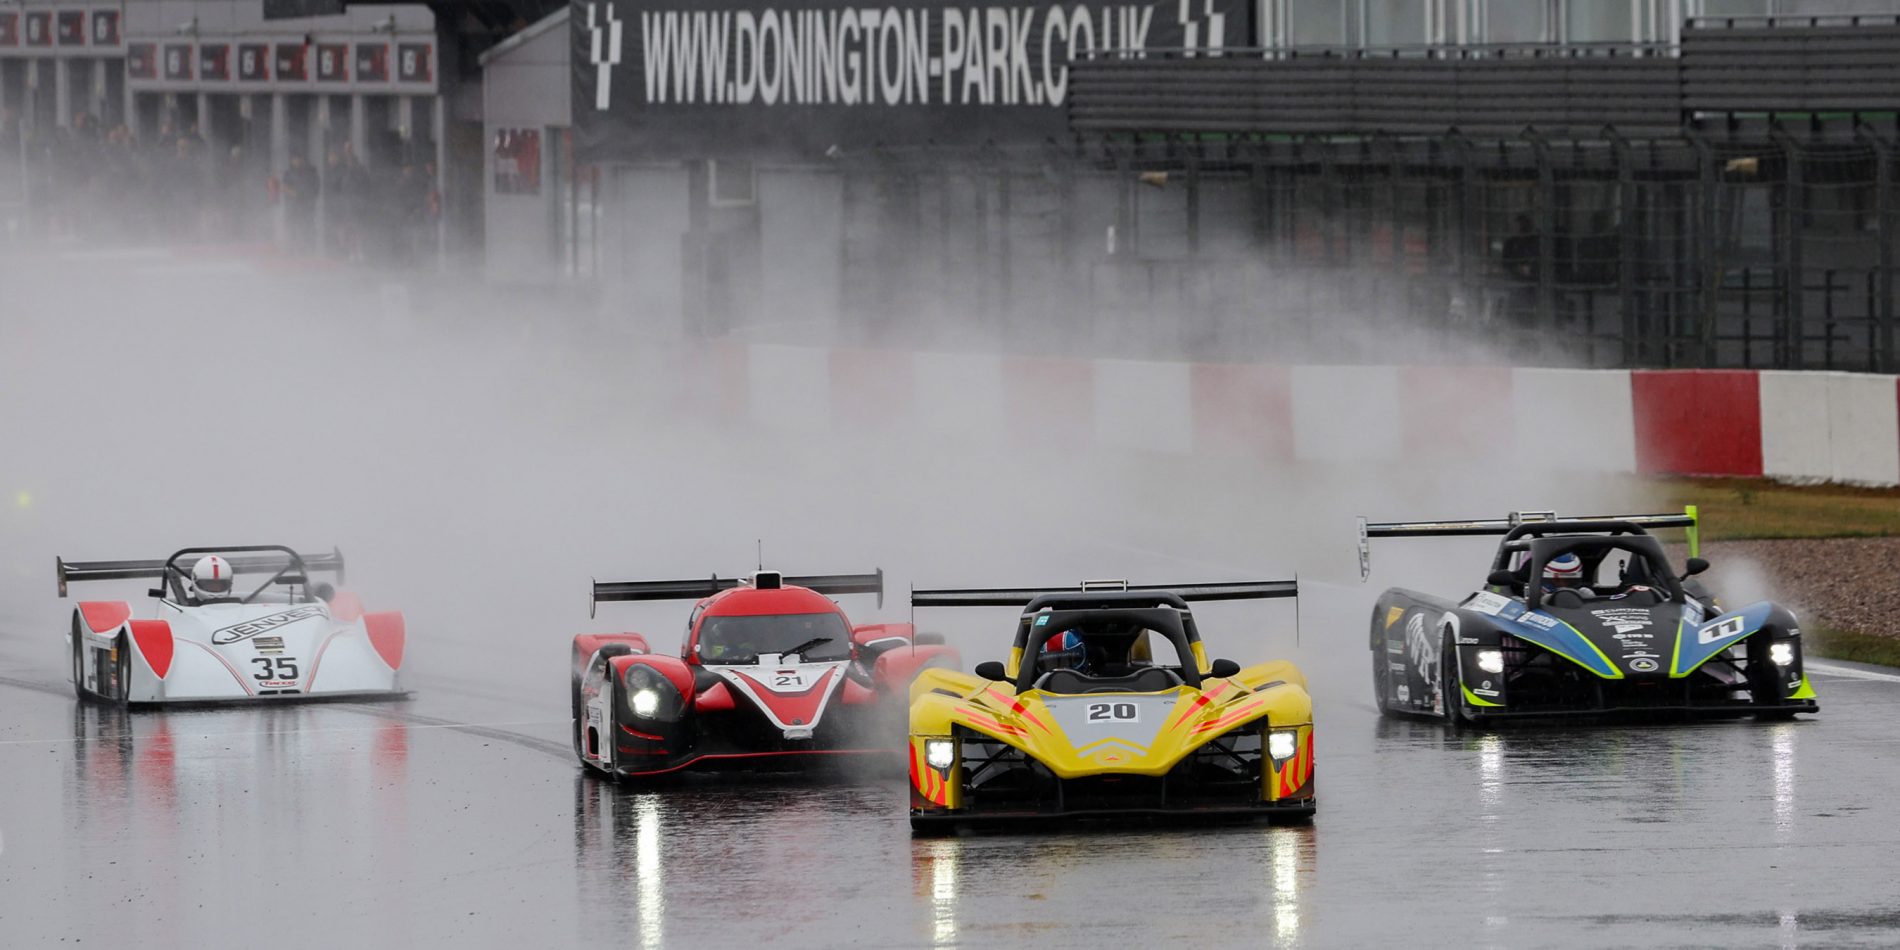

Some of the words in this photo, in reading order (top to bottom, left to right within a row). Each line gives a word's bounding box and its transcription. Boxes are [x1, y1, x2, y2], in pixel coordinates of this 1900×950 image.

[641, 5, 1154, 107] WWW.DONINGTON-PARK.COUK
[1704, 619, 1738, 639] 11
[251, 657, 299, 680] 35
[775, 676, 802, 686] 21
[1090, 704, 1136, 720] 20
